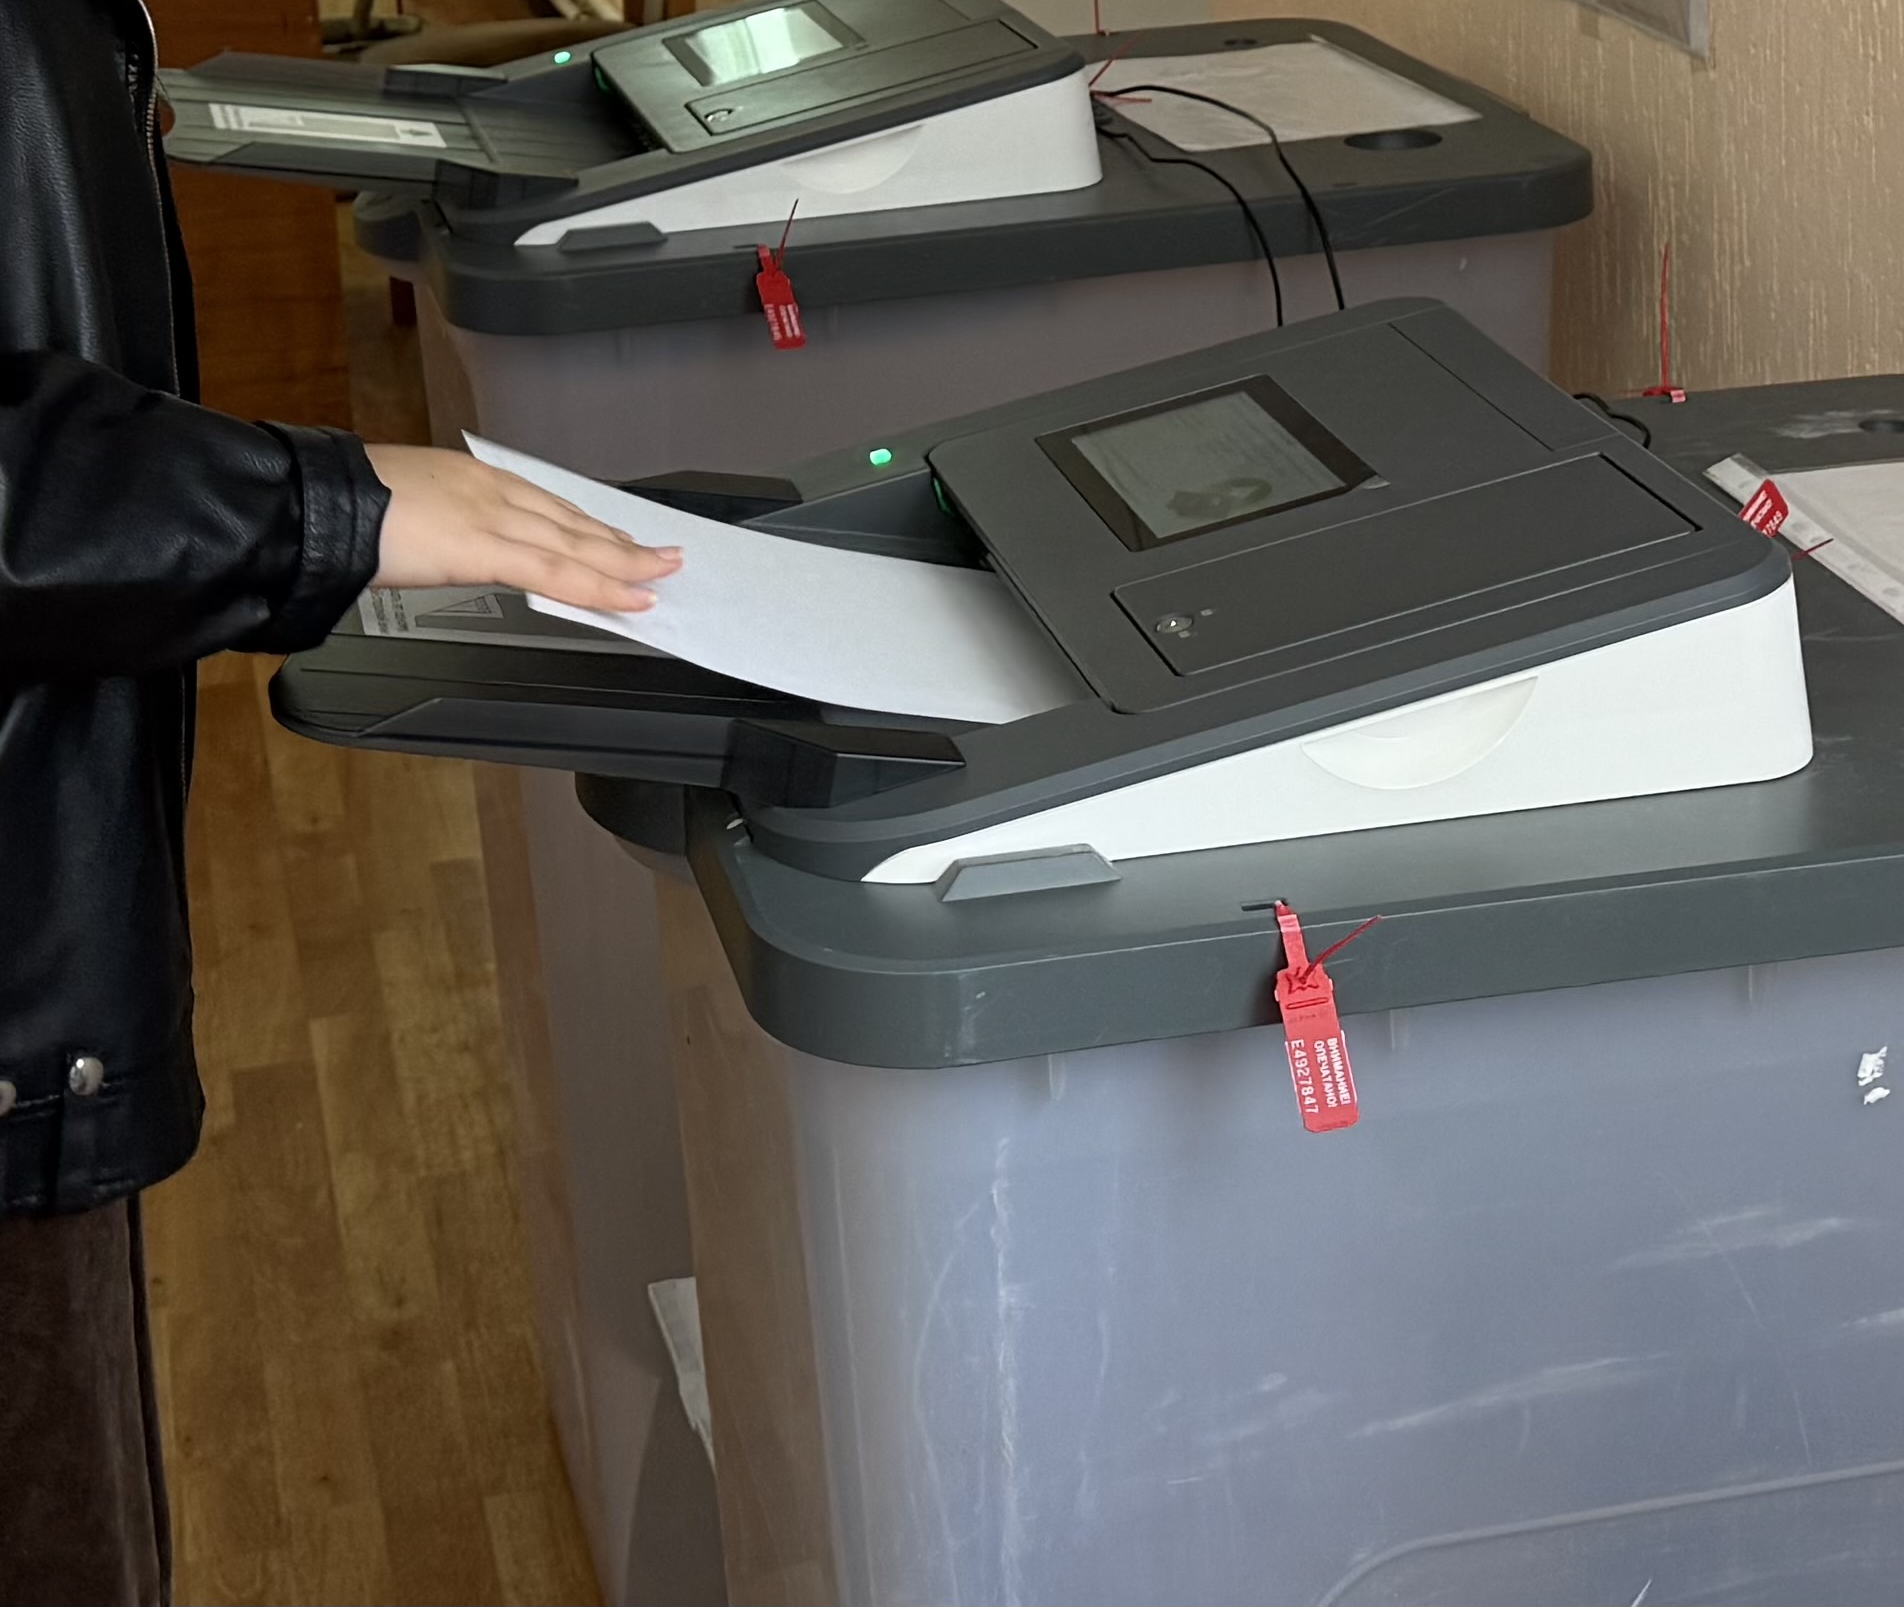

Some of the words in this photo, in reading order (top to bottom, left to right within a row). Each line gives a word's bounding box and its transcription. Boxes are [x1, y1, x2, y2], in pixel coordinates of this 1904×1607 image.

[1291, 1039, 1319, 1113] E4927847
[1314, 1040, 1337, 1107] ОПЕЧАТАНО!
[1327, 1037, 1351, 1105] ВНИМАНИЕ!
